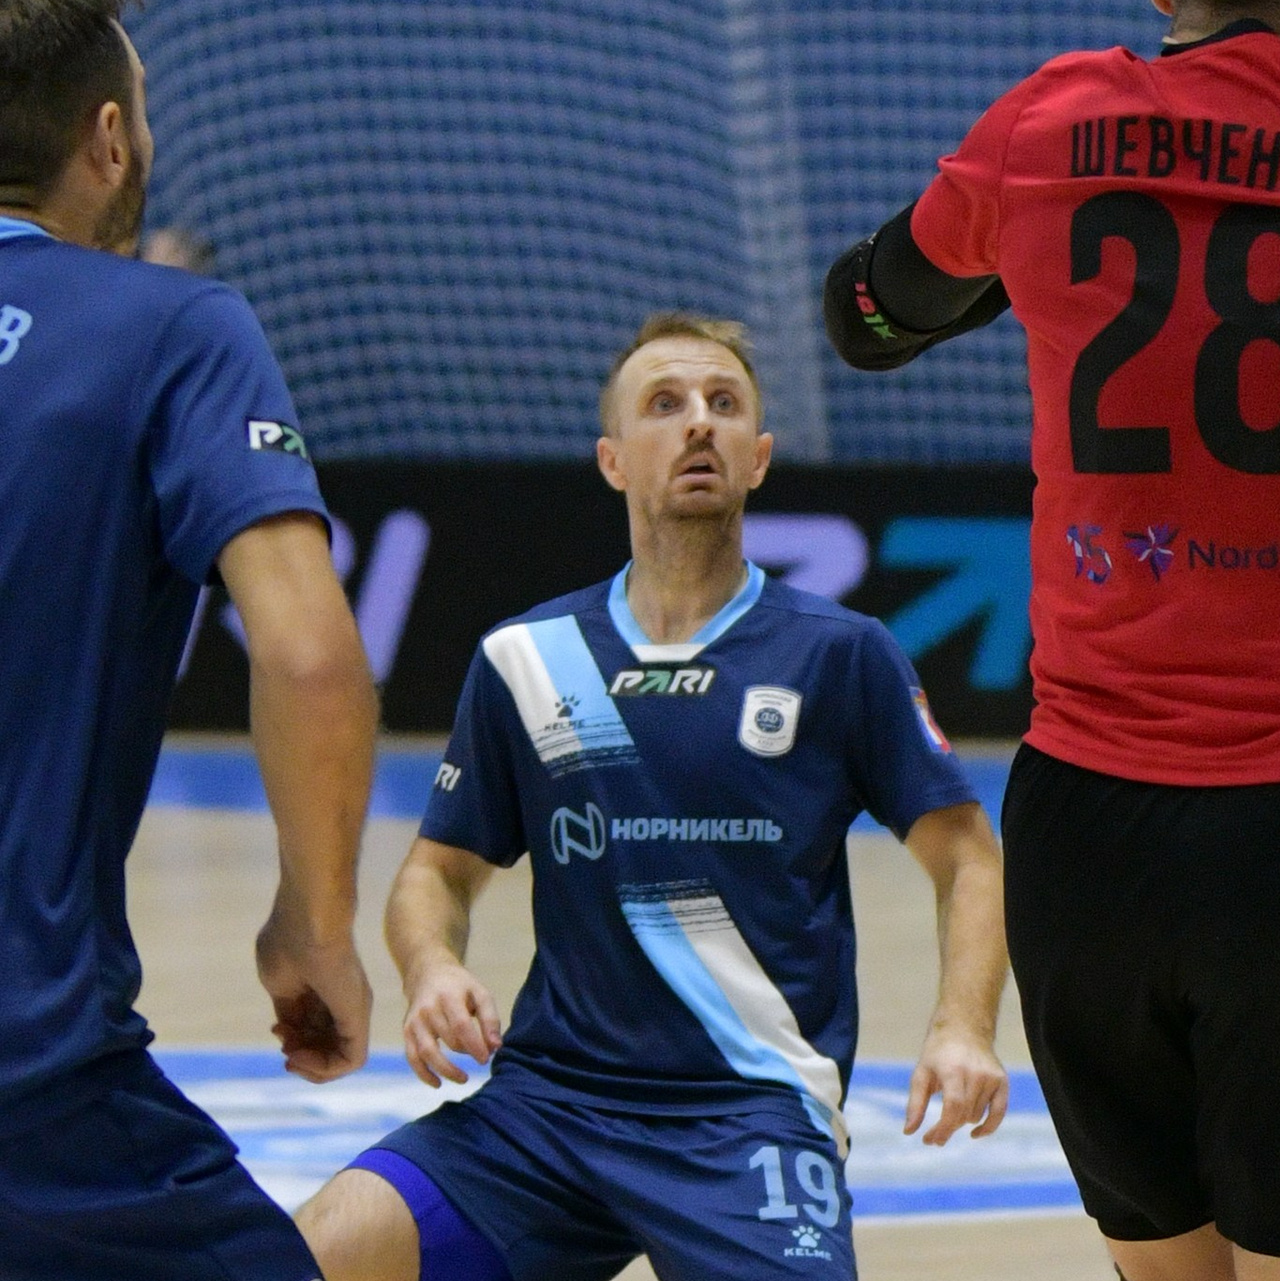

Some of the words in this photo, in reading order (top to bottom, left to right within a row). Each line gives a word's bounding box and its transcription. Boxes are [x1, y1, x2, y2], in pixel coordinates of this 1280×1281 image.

[609, 669, 716, 695] PARI
[611, 817, 784, 842] НОРНИКЕЛЬ
[749, 1146, 841, 1228] 19
